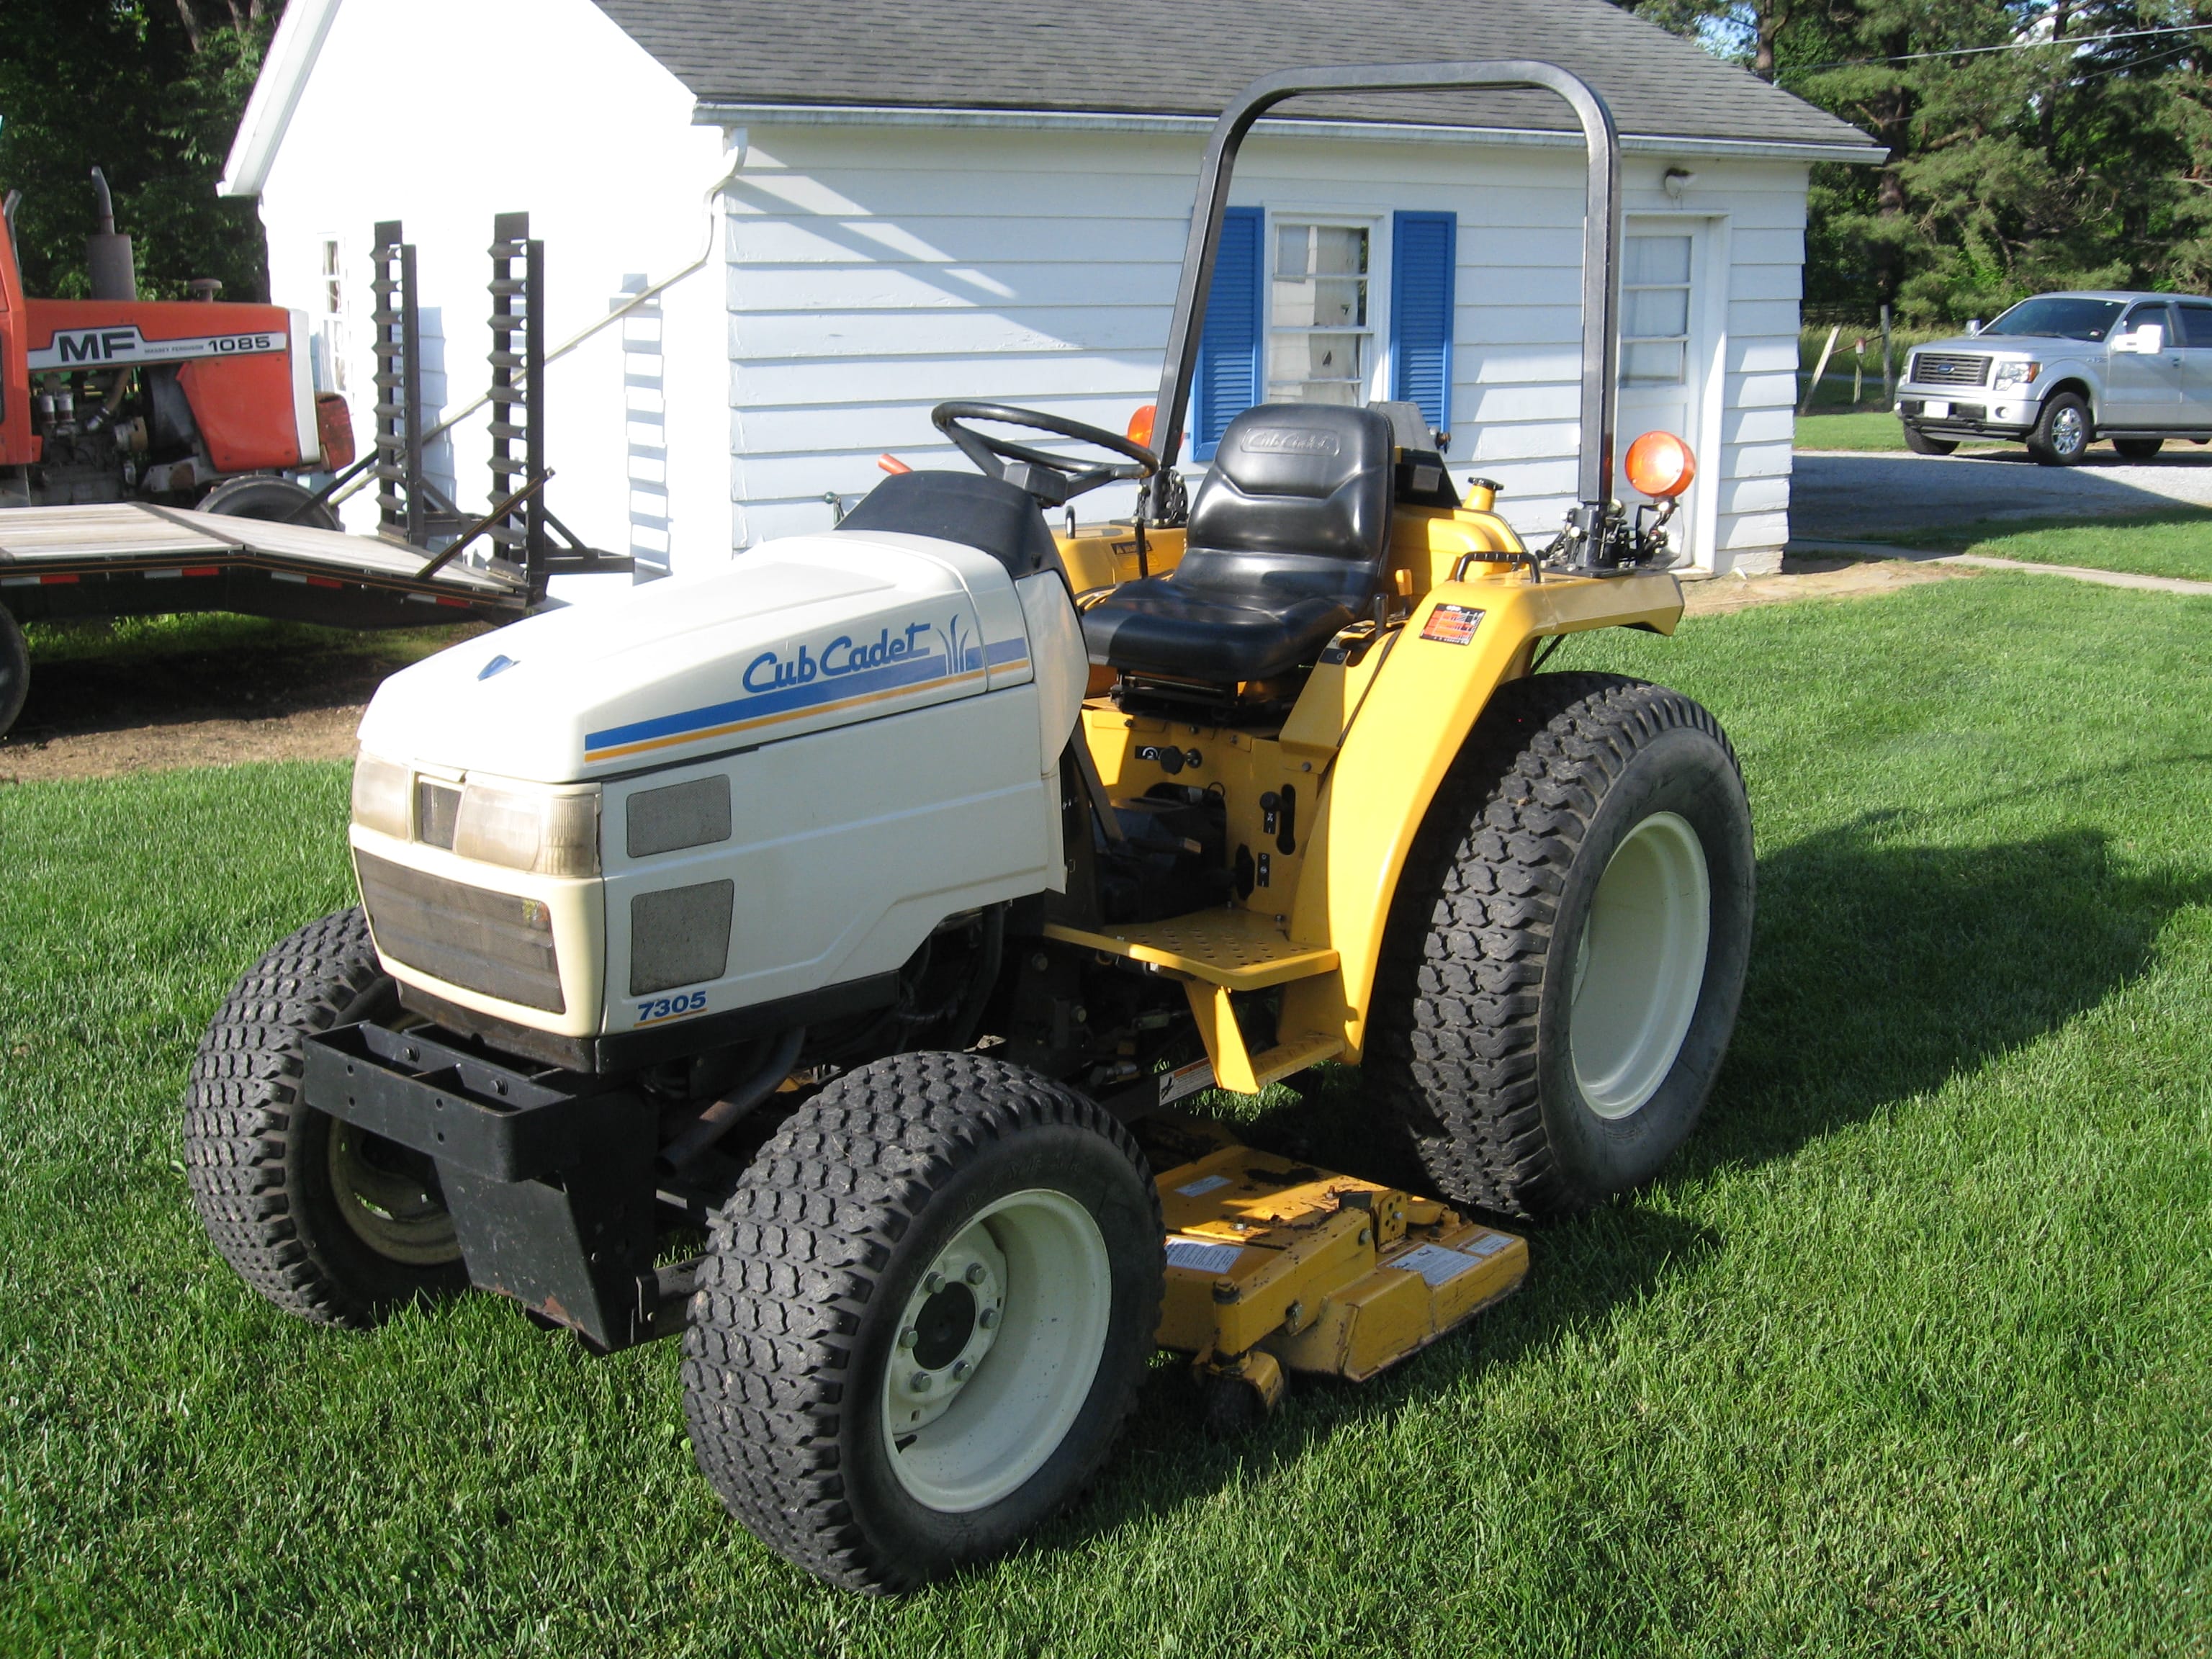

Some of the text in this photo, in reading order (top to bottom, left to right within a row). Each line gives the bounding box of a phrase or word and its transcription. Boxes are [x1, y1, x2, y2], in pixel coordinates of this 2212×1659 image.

[58, 331, 135, 362] MF
[208, 336, 271, 352] 1085
[742, 622, 930, 693] Cub Cadet
[638, 991, 706, 1021] 7305
